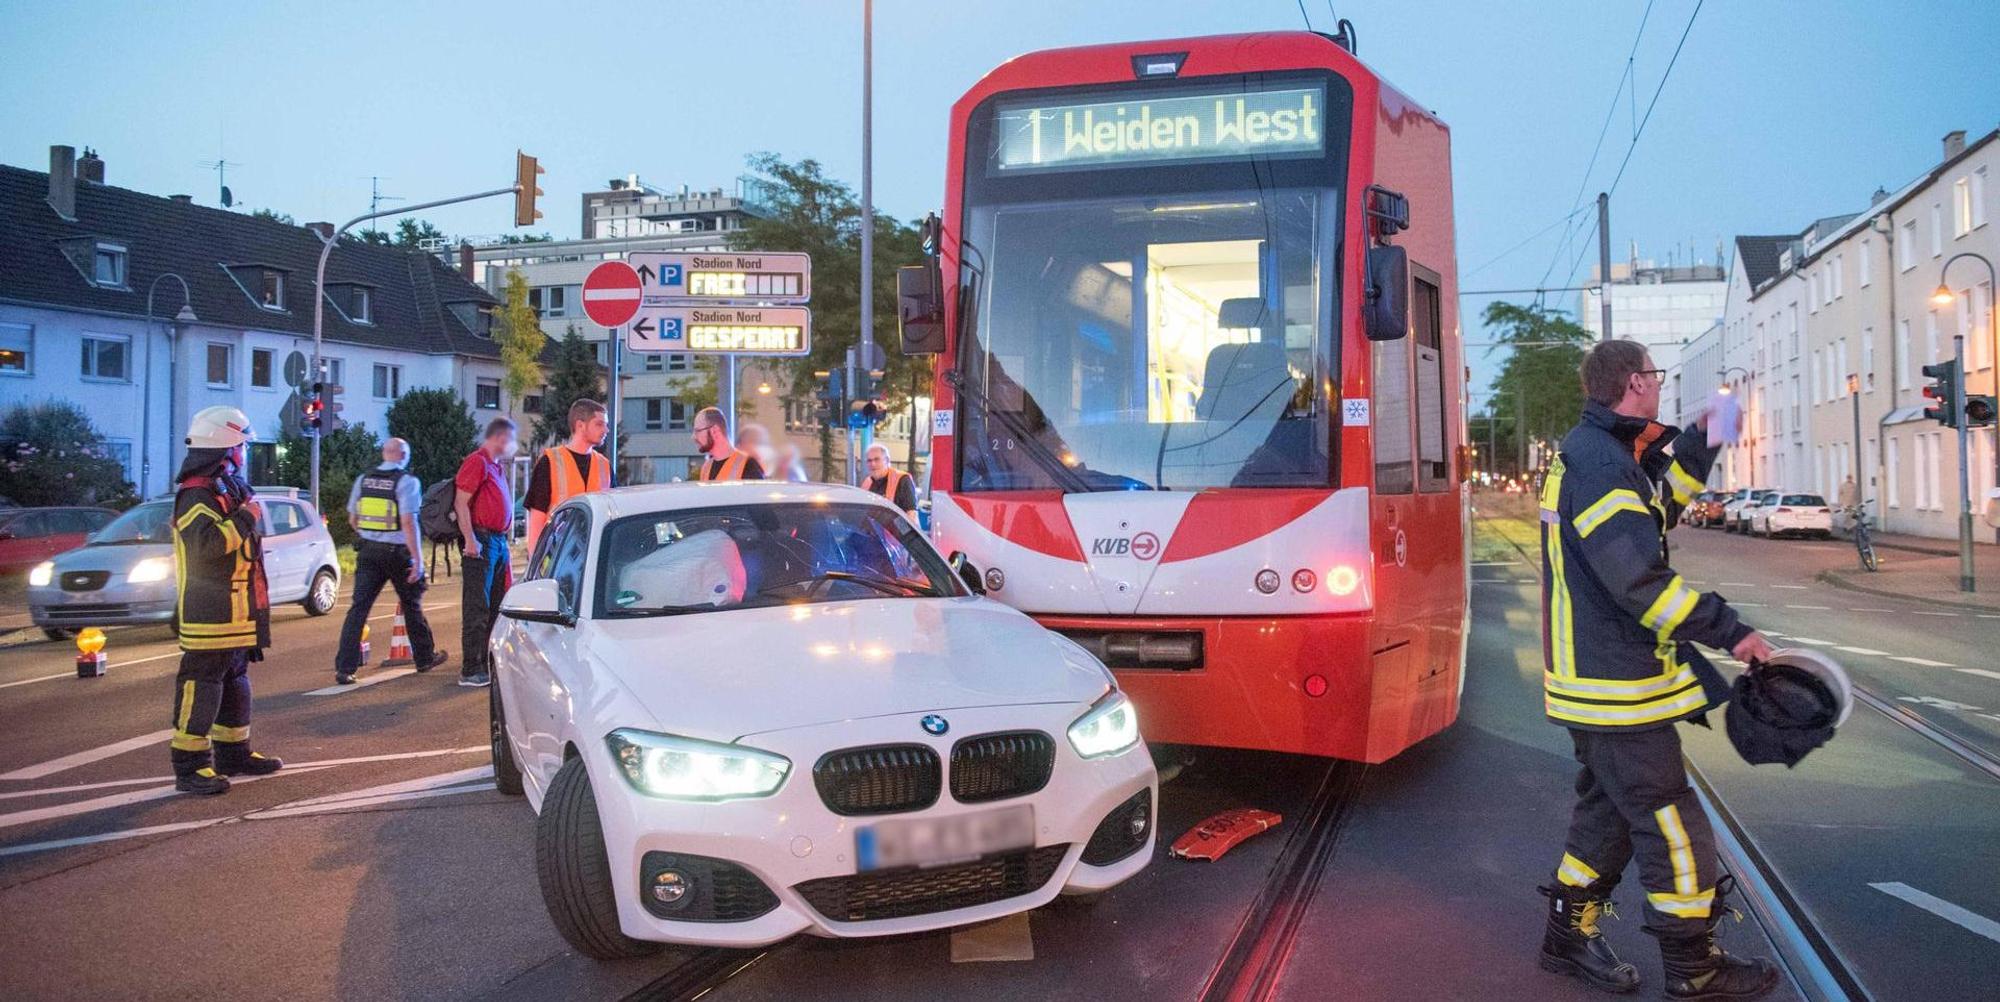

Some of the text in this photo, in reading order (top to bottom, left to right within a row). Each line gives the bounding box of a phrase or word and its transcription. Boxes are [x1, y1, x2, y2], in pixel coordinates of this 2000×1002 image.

[1028, 95, 1318, 164] 1 Weiden West
[692, 257, 762, 269] Stadion Nord
[690, 273, 745, 295] FREI
[692, 312, 762, 323] Stadion Nord
[690, 327, 799, 349] GESPERRT
[1092, 538, 1129, 555] KVB
